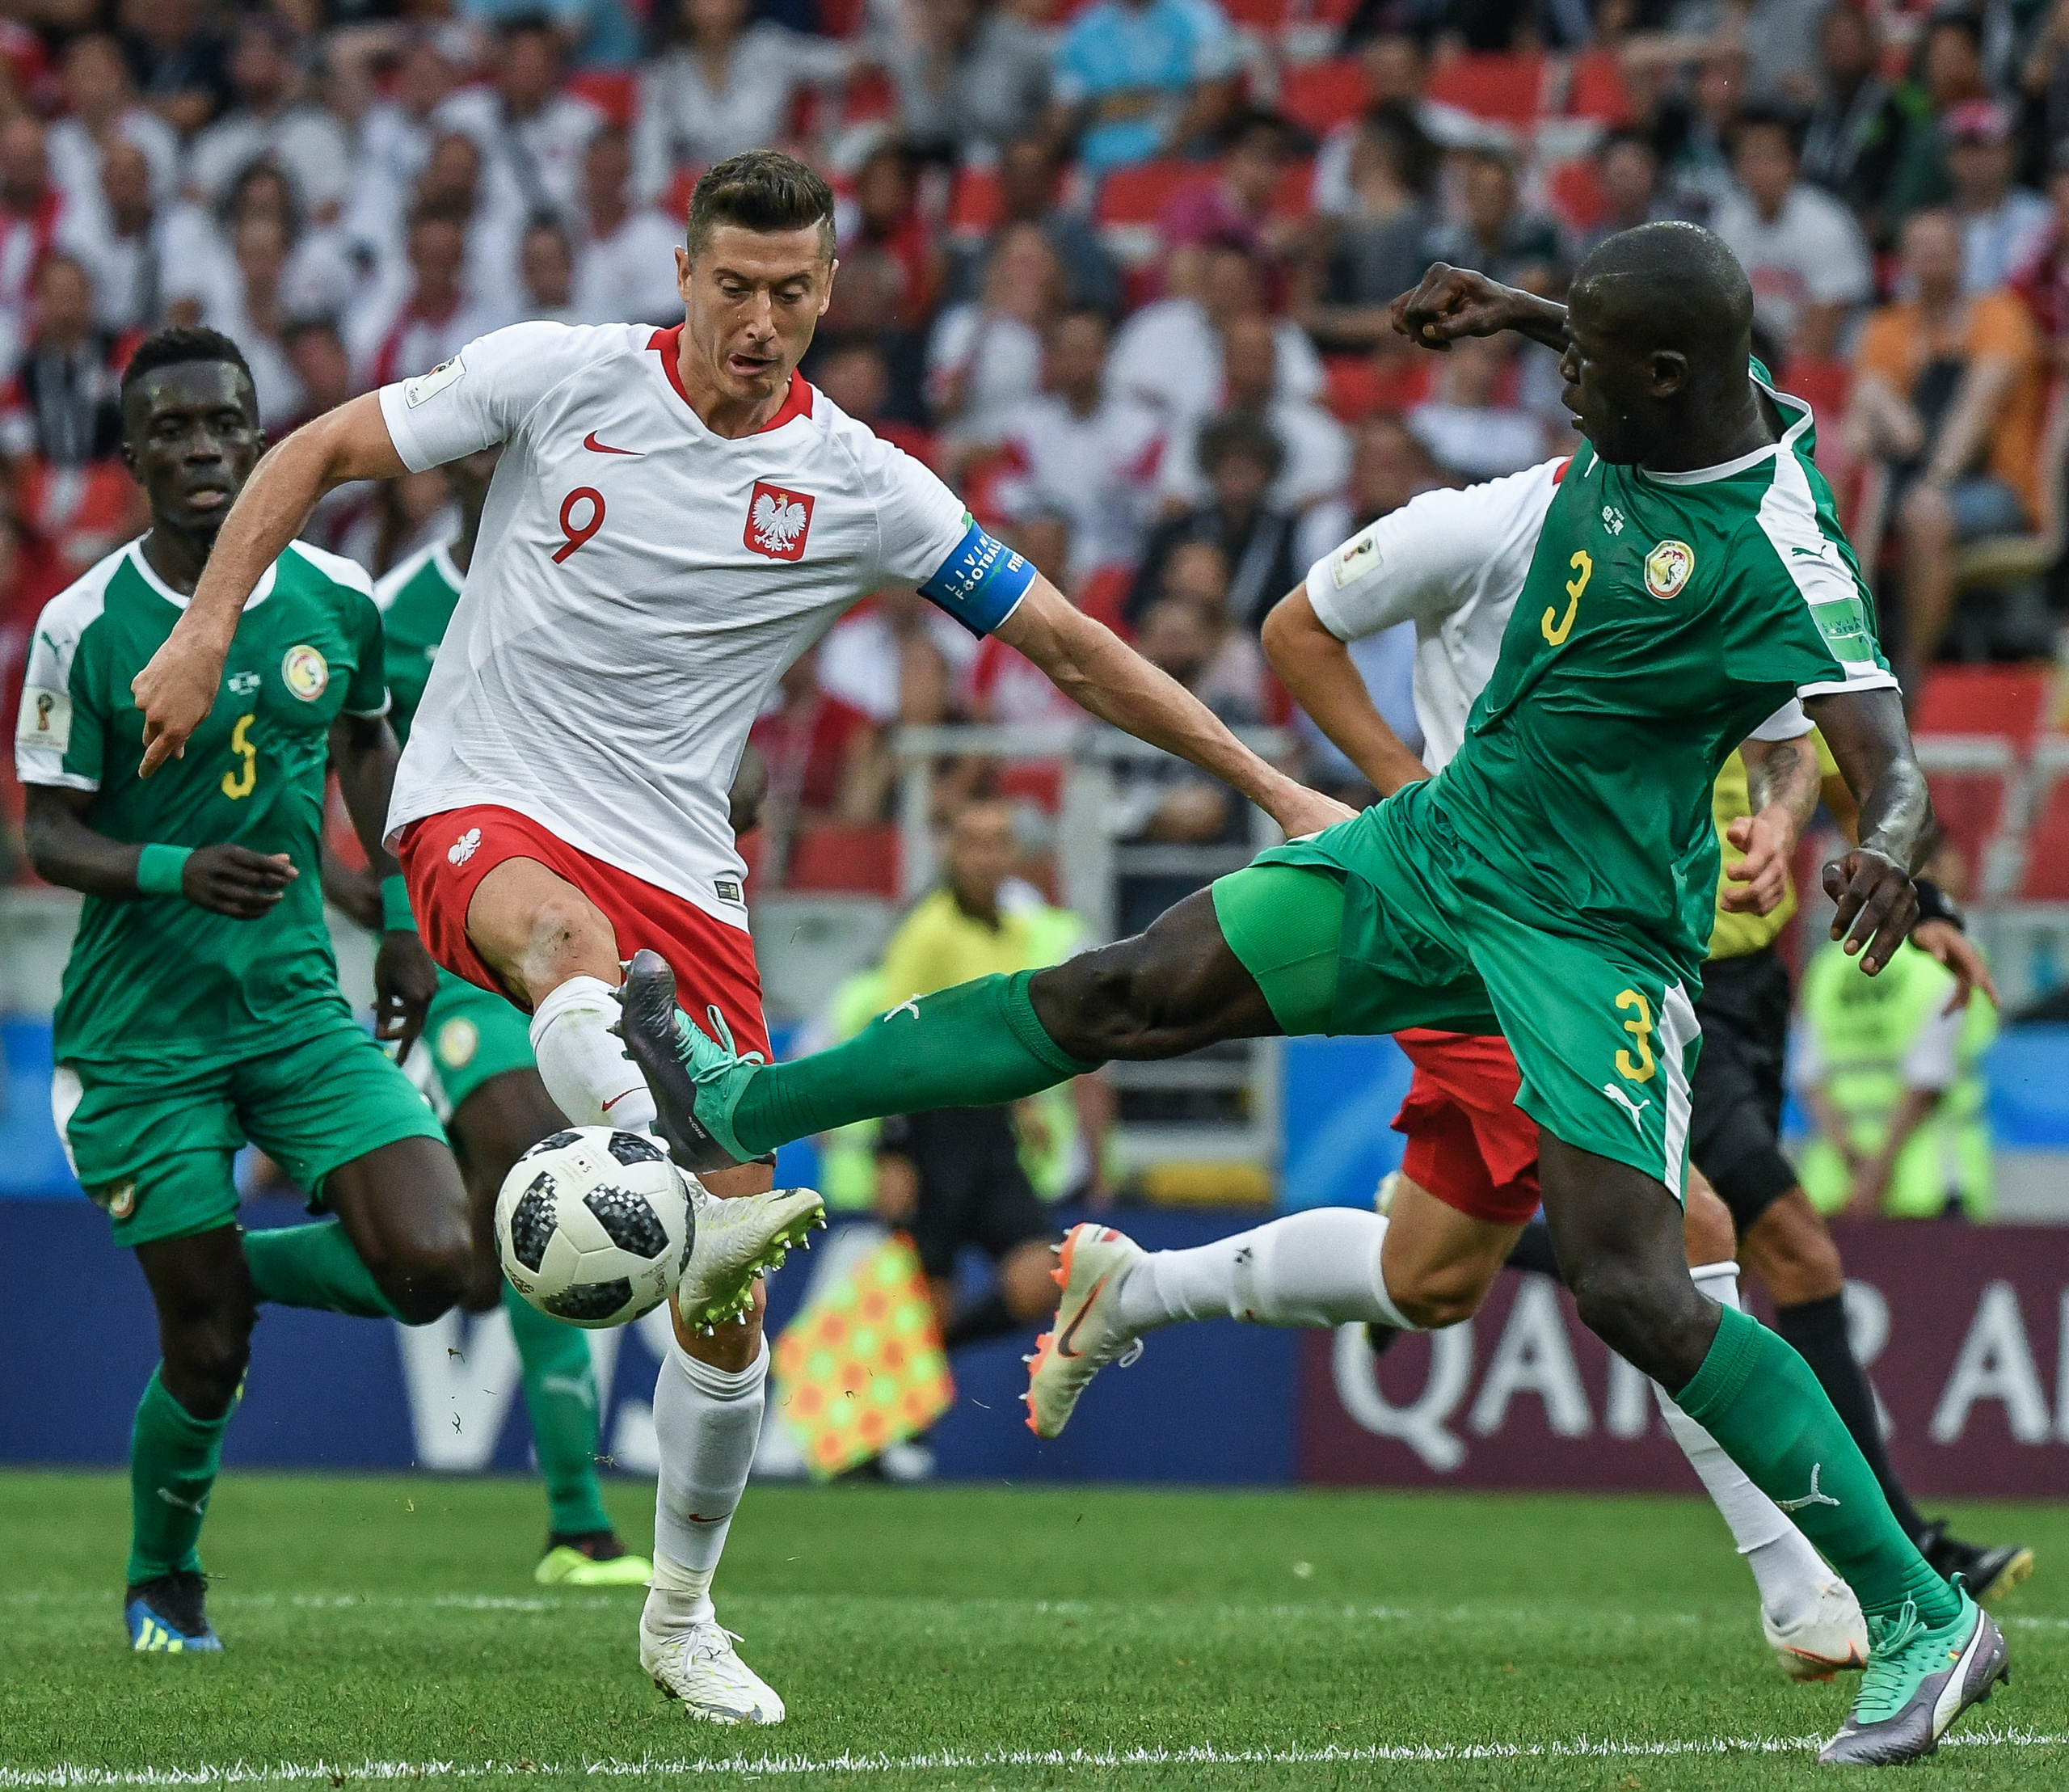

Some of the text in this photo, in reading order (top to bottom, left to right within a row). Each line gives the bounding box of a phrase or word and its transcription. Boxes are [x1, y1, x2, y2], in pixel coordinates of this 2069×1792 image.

[551, 487, 606, 564] 9
[1541, 550, 1592, 646] 3
[221, 714, 257, 800] 5
[1615, 989, 1655, 1083] 3
